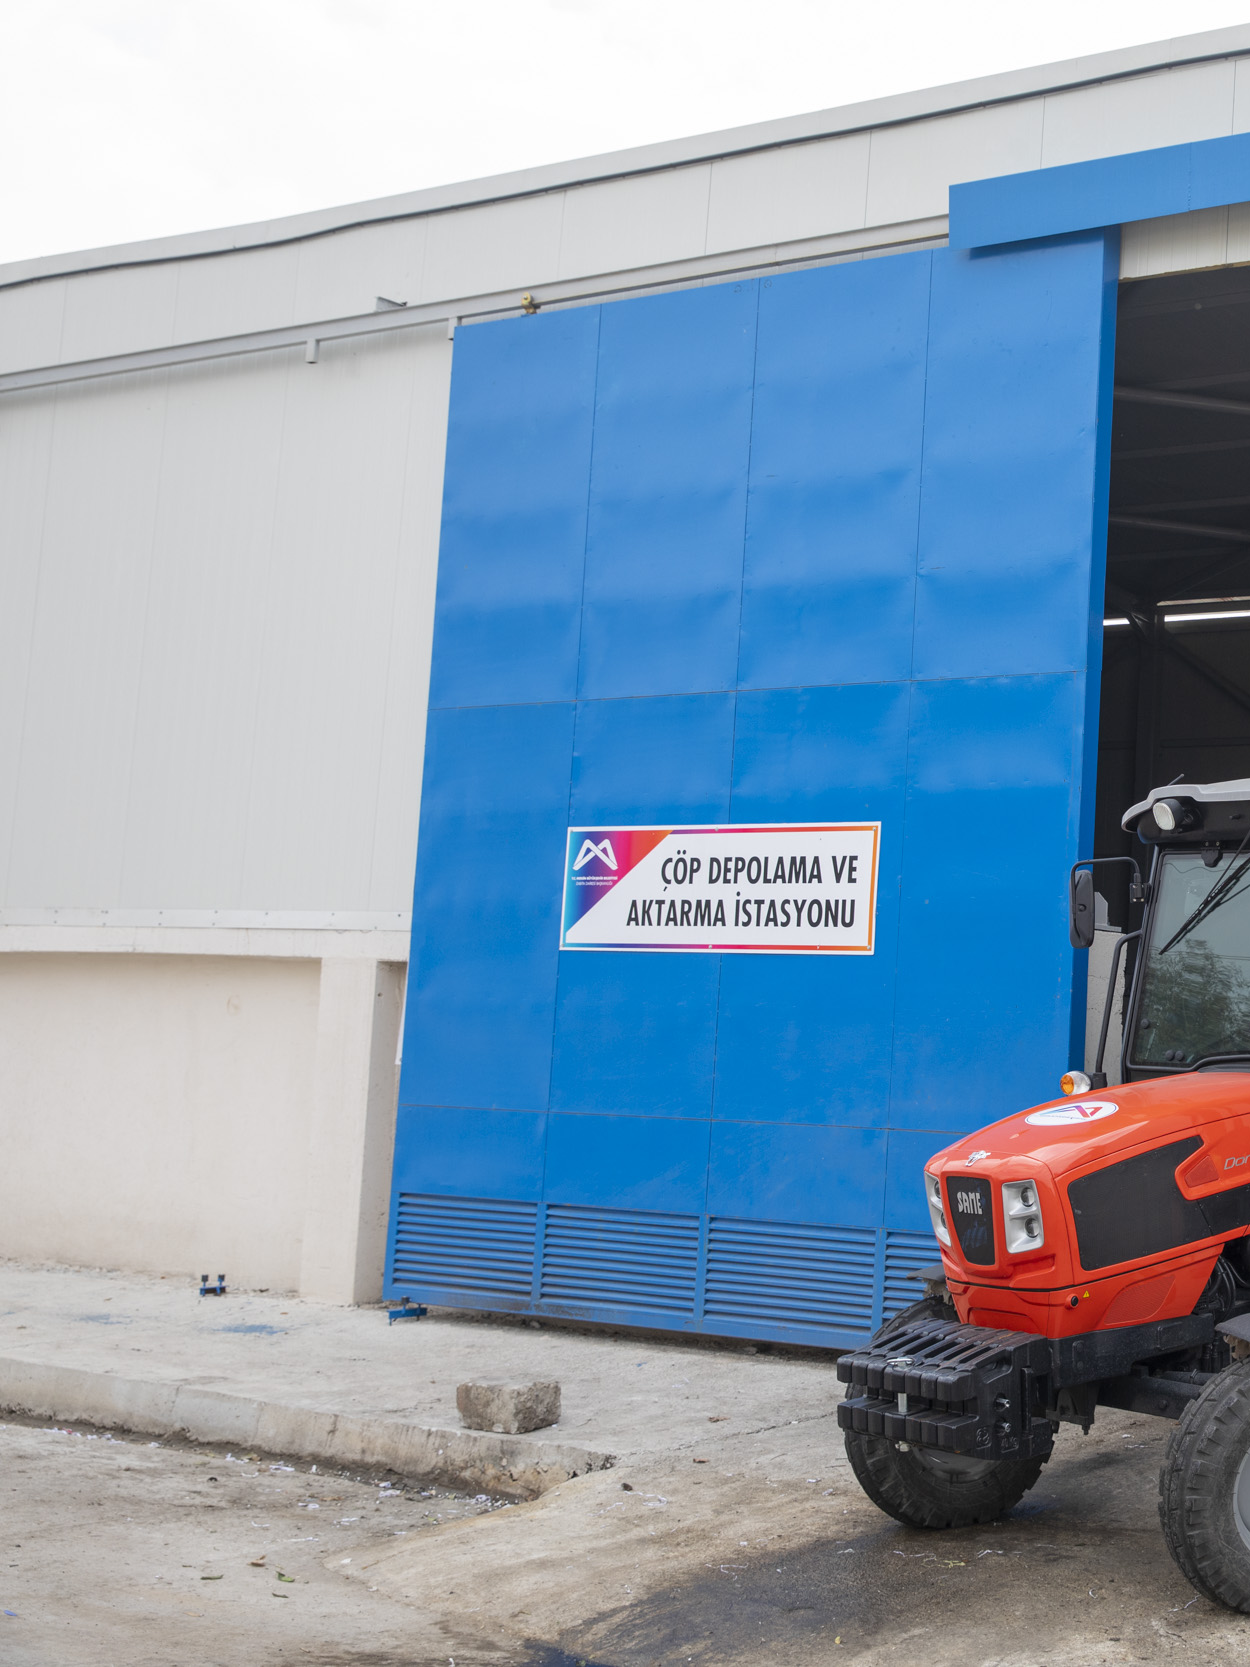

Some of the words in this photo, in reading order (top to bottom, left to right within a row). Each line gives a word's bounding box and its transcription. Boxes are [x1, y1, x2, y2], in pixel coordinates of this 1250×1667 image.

[661, 850, 701, 892] ÇÖP
[708, 855, 823, 885] DEPOLAMA
[832, 855, 859, 884] VE
[626, 899, 727, 927] AKTARMA
[734, 891, 856, 928] İSTASYONU
[956, 1191, 983, 1215] SAME
